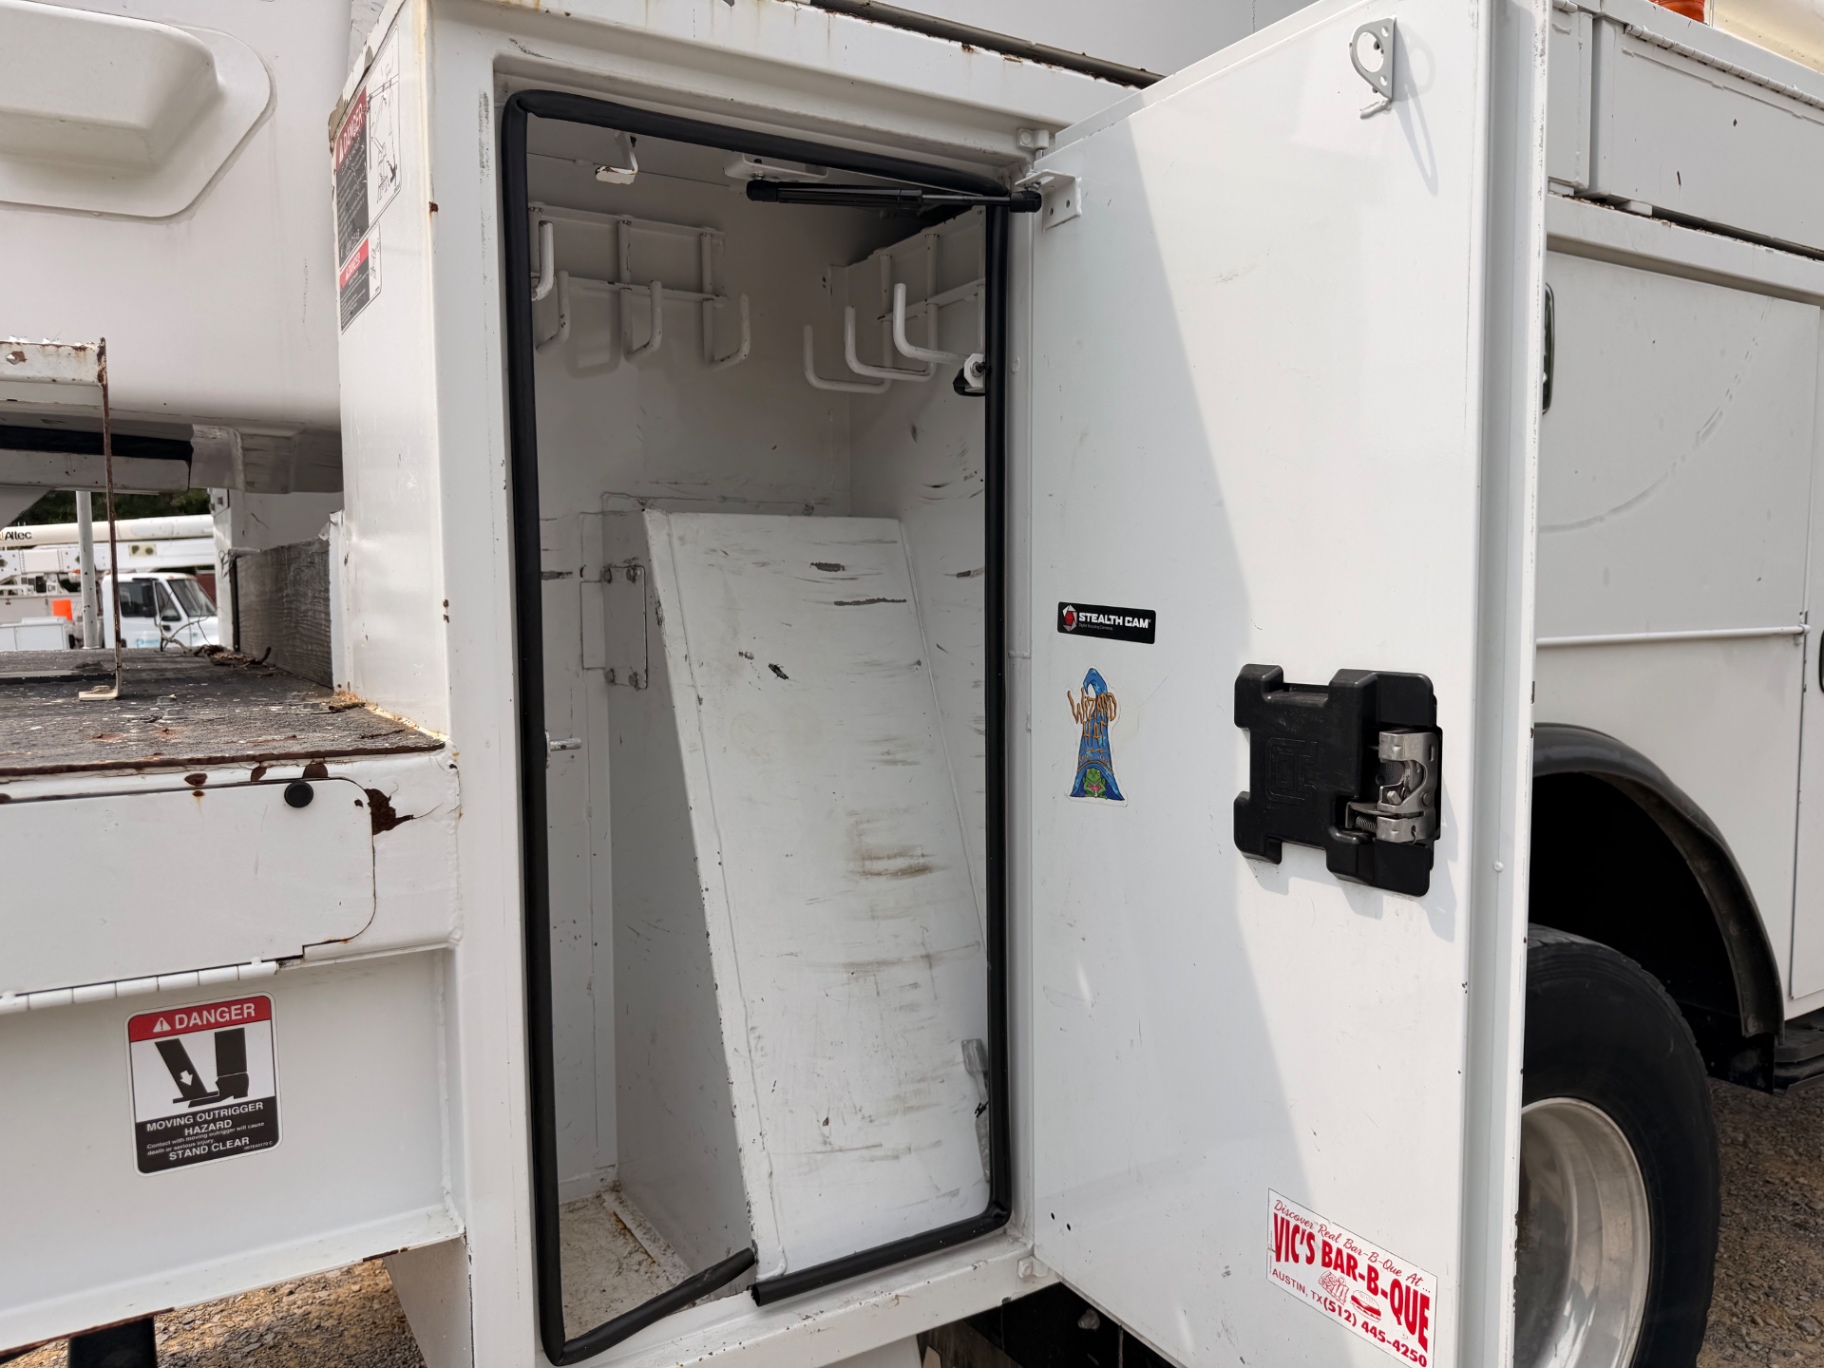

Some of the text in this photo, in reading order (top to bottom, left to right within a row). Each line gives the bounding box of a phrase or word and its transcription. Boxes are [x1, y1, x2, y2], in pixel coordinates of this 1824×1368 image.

[5, 531, 32, 540] Altec
[1079, 612, 1149, 629] STEALTH CAM
[174, 1003, 255, 1029] DANGER
[146, 1101, 264, 1132] MOVING OUTRIGGER
[184, 1119, 233, 1136] HAZARD
[146, 1140, 171, 1149] Contact
[186, 1133, 208, 1142] moving
[169, 1145, 209, 1160] STAND
[211, 1136, 250, 1152] CLEAR
[173, 1142, 196, 1150] serious
[1273, 1199, 1314, 1230] Discover
[1317, 1223, 1342, 1244] Real
[1343, 1238, 1403, 1277] Bar-B-Que
[1273, 1211, 1316, 1266] VIC'S
[1321, 1238, 1430, 1354] BAR-B-QUE
[1272, 1268, 1308, 1297] AUSTIN,
[1310, 1289, 1323, 1305] TX
[1361, 1320, 1428, 1368] 445-4250
